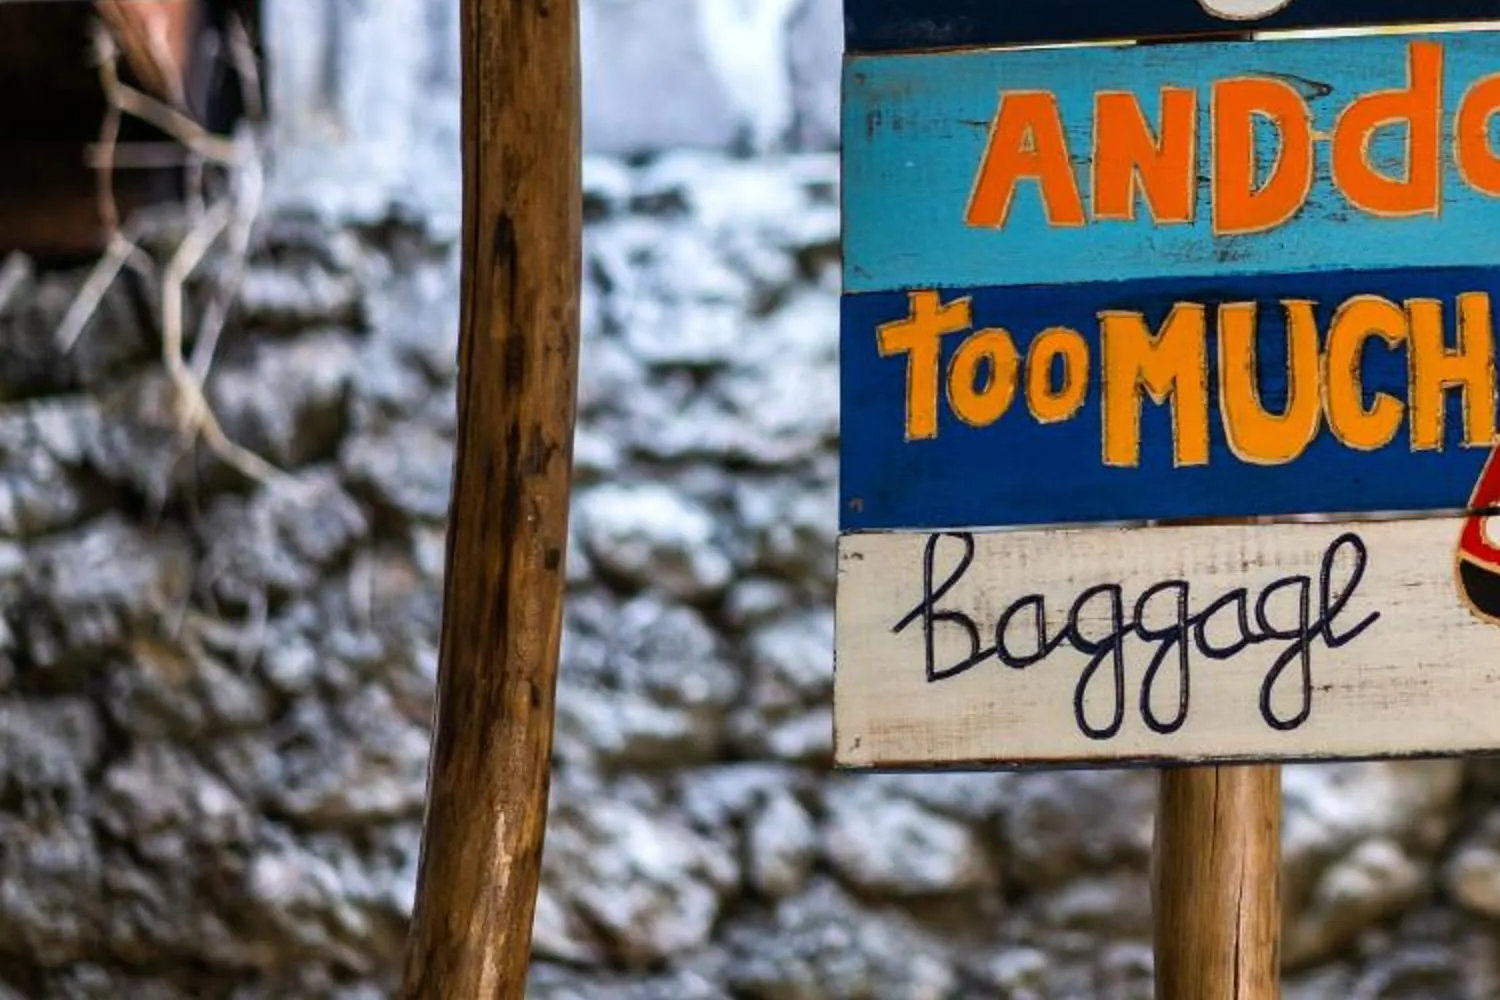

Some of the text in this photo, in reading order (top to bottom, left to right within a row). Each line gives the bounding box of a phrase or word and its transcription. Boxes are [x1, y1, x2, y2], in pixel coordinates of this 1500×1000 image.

[963, 74, 1315, 236] AND
[876, 290, 1500, 467] too MUCH
